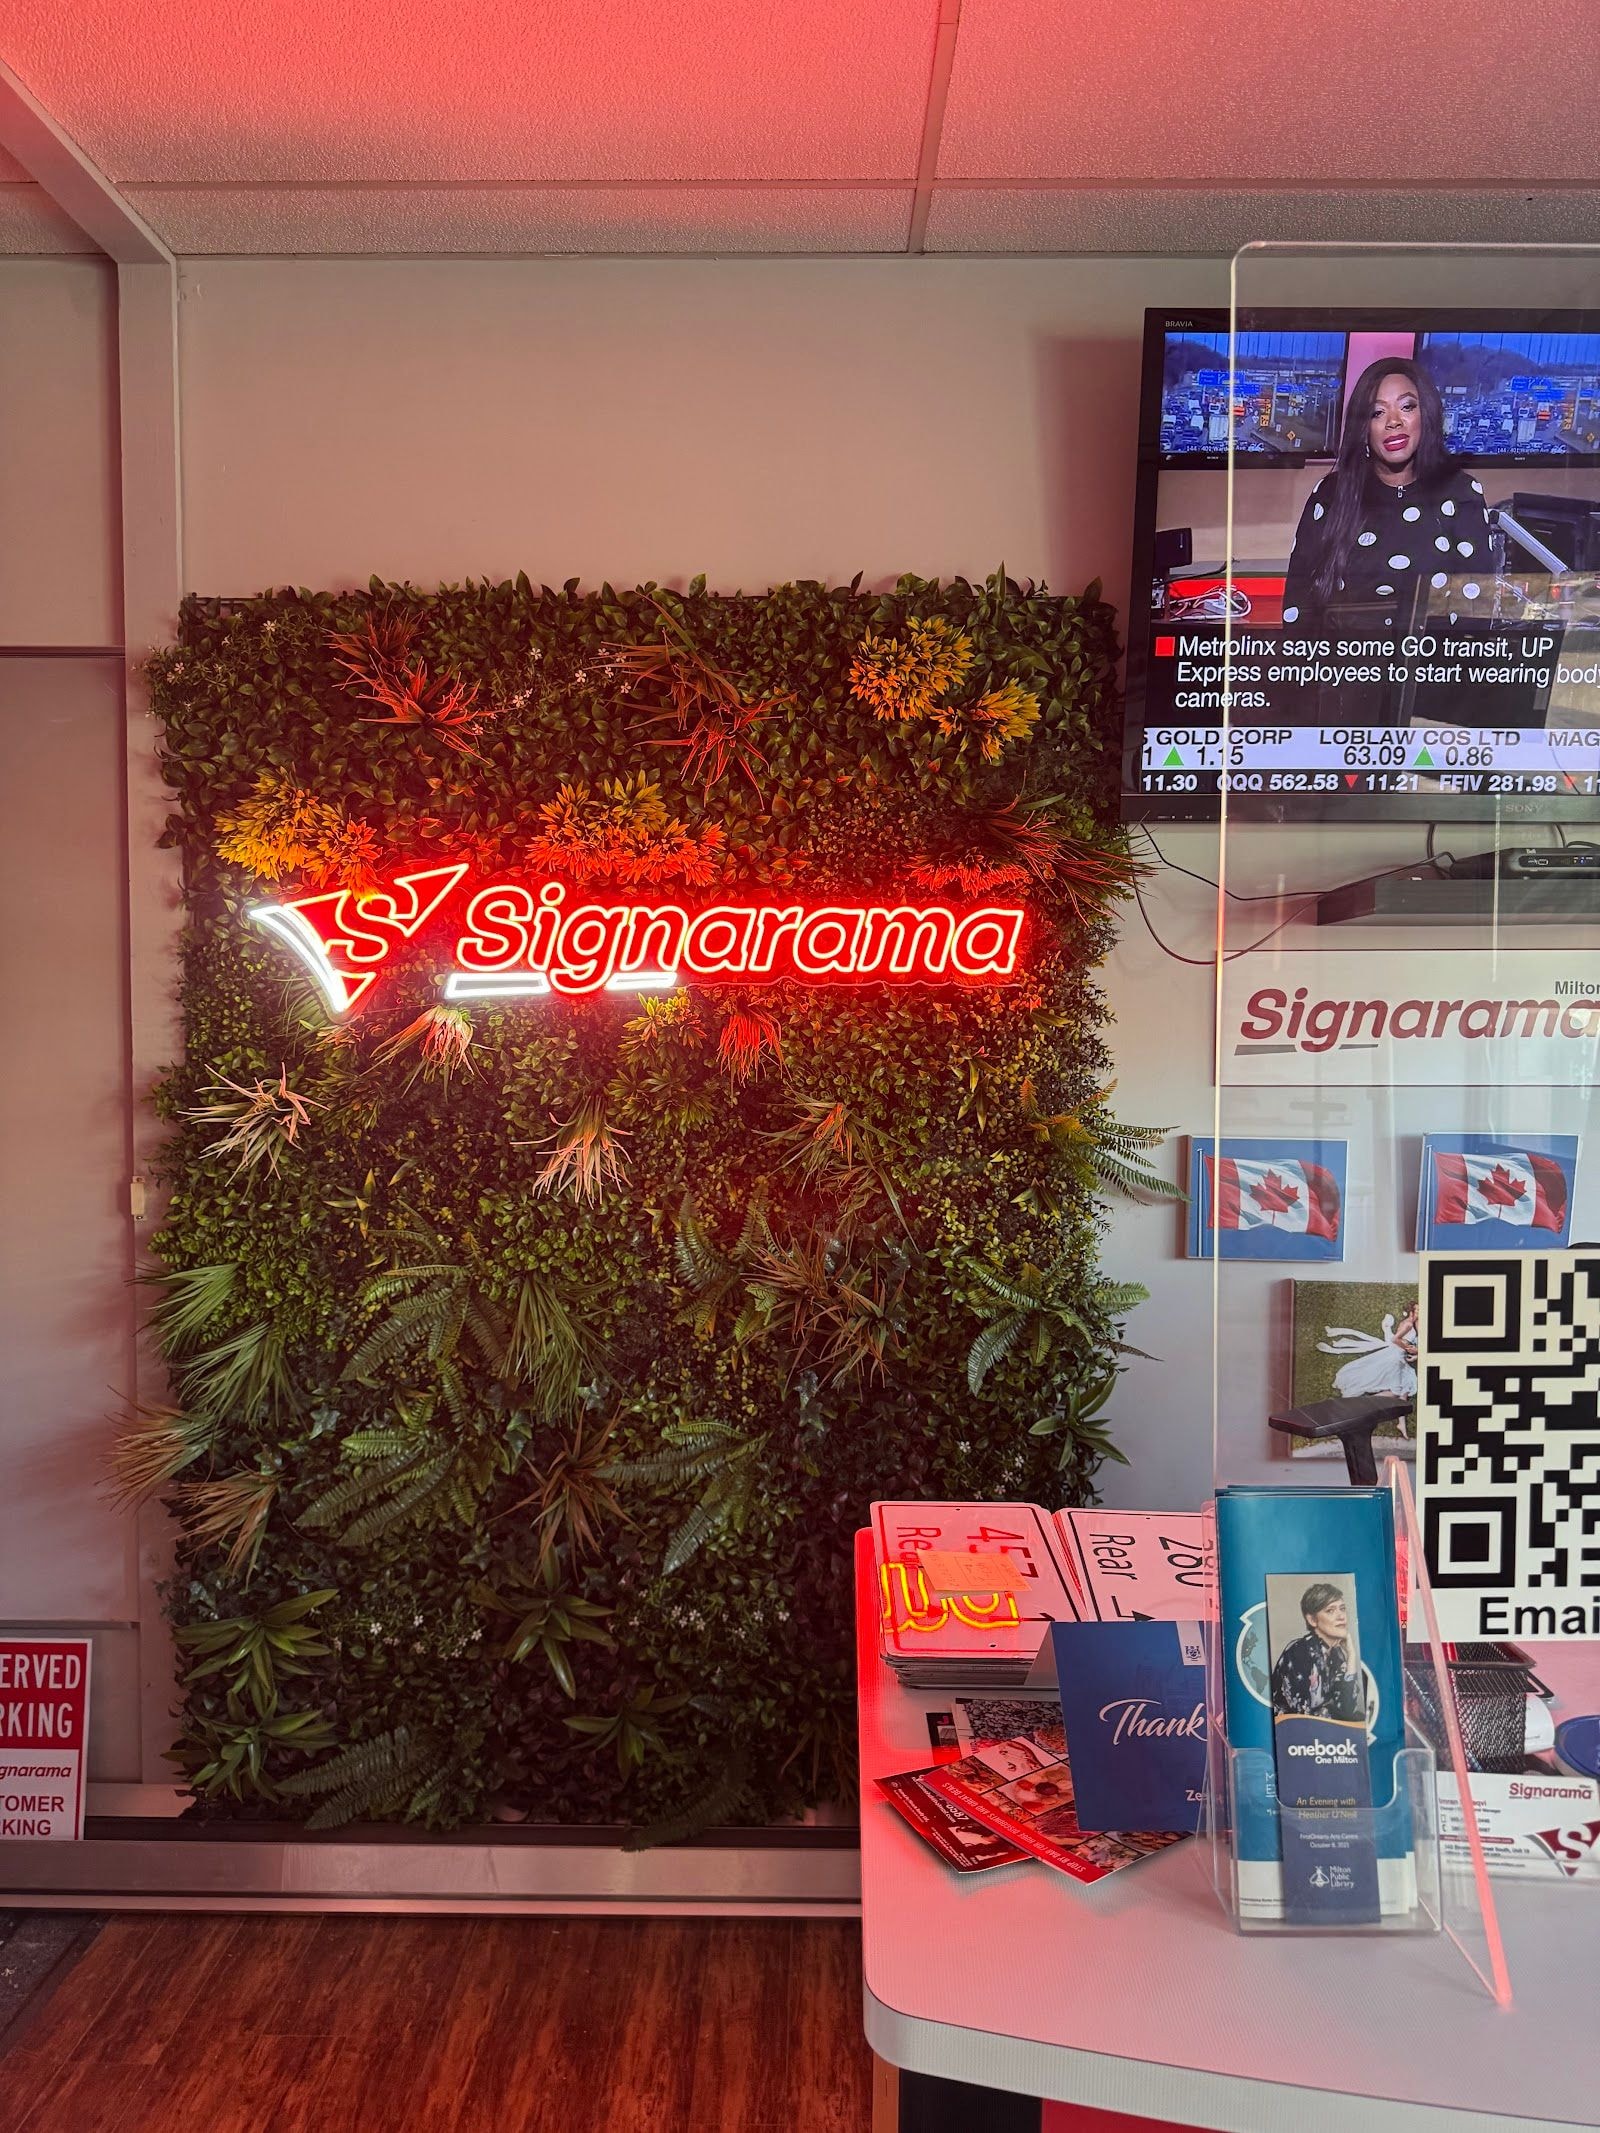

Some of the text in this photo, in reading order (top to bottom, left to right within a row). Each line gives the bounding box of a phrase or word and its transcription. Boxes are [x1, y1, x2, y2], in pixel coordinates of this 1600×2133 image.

[1178, 636, 1554, 661] Metrolinx says some GO transit, UP
[1177, 661, 1600, 688] Express employees to start wearing bod
[1175, 691, 1271, 708] cameras.
[1156, 730, 1220, 745] GOLD
[1228, 730, 1293, 745] CORP
[1319, 729, 1520, 746] LOBLAW COS LTD
[1548, 731, 1600, 747] MAG
[1343, 746, 1493, 766] 63.09 0.86
[1142, 774, 1198, 791] 11.30
[1216, 774, 1264, 792] QQQ
[1269, 774, 1339, 792] 562.58
[1365, 774, 1420, 792] 11.21
[1438, 775, 1485, 792] FFIV
[1487, 775, 1557, 792] 281.98
[1505, 804, 1544, 813] SONY
[456, 882, 1028, 988] Signarama
[1240, 987, 1600, 1052] Signarama
[1089, 1533, 1138, 1581] Rear
[1099, 1698, 1208, 1746] Thank
[1287, 1738, 1358, 1756] onebook
[1315, 1756, 1359, 1764] One Milton
[1509, 1783, 1592, 1800] Signarama
[1296, 1797, 1356, 1808] An Evening with
[0, 1819, 51, 1836] KING
[1066, 1861, 1087, 1873] STOP
[1329, 1865, 1351, 1874] Milton
[1330, 1880, 1355, 1889] Library
